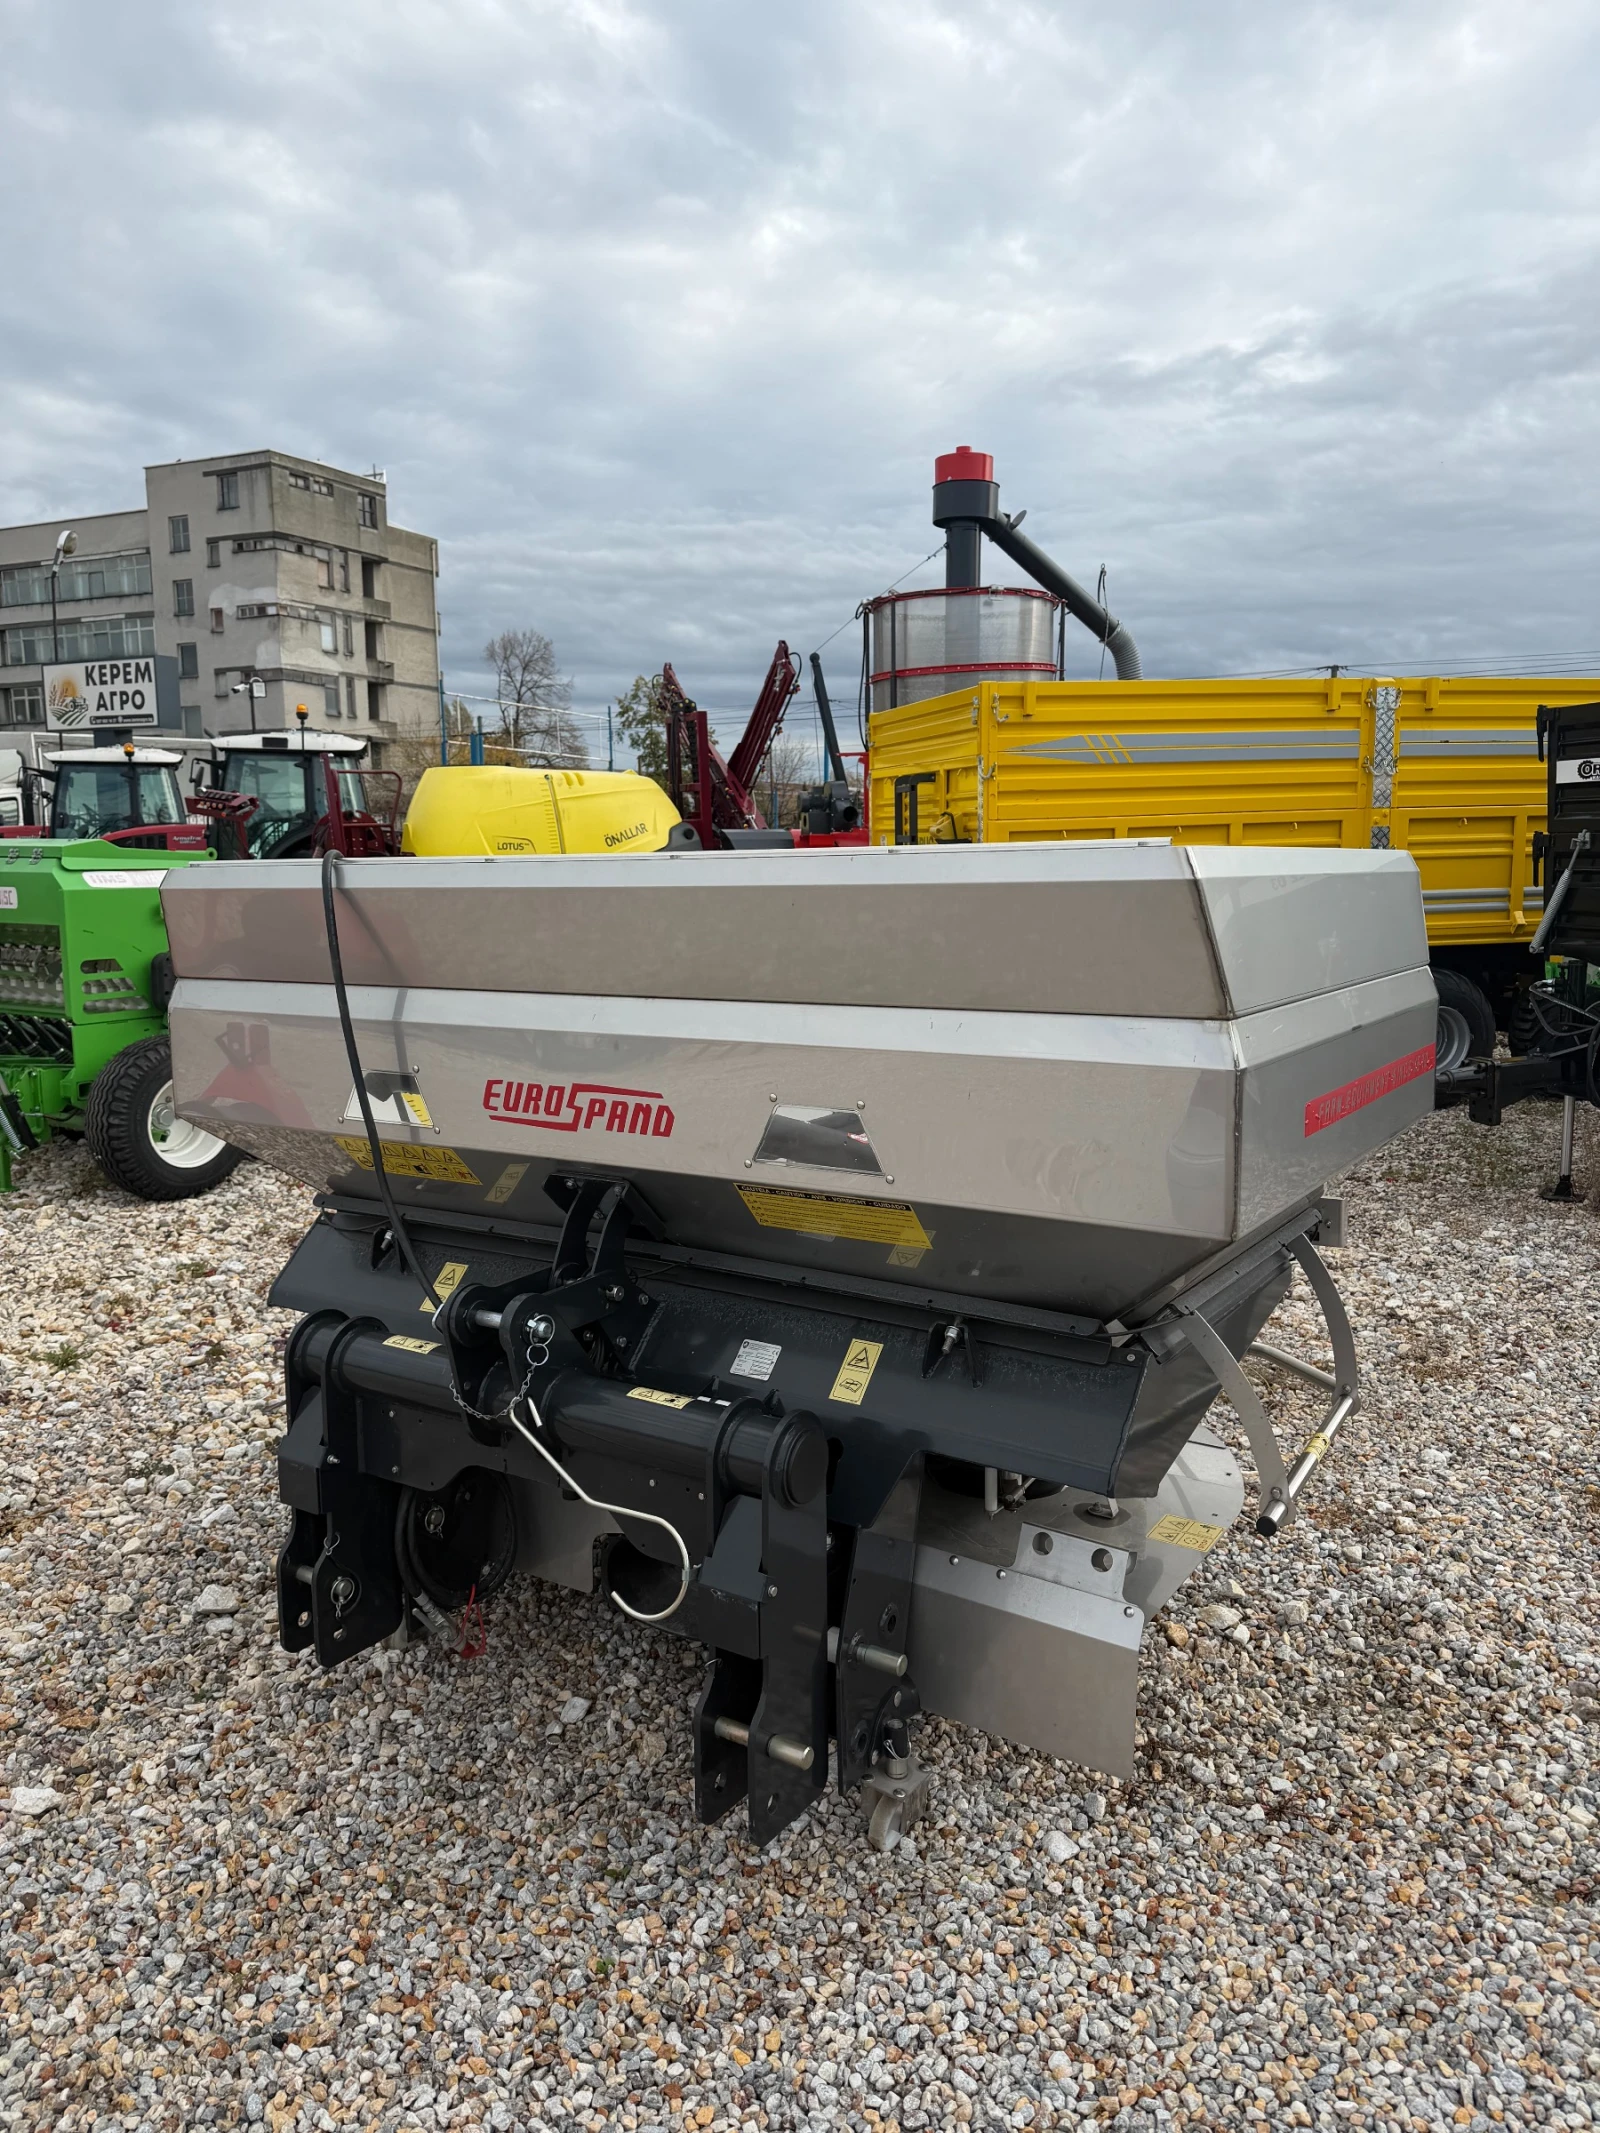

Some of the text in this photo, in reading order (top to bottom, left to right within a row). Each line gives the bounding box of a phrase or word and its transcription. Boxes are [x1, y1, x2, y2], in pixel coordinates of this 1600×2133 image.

[85, 662, 153, 687] КЕРЕМ
[96, 689, 146, 712] АГРО
[497, 842, 525, 851] LOTUS
[604, 823, 648, 848] ÖNALLAR
